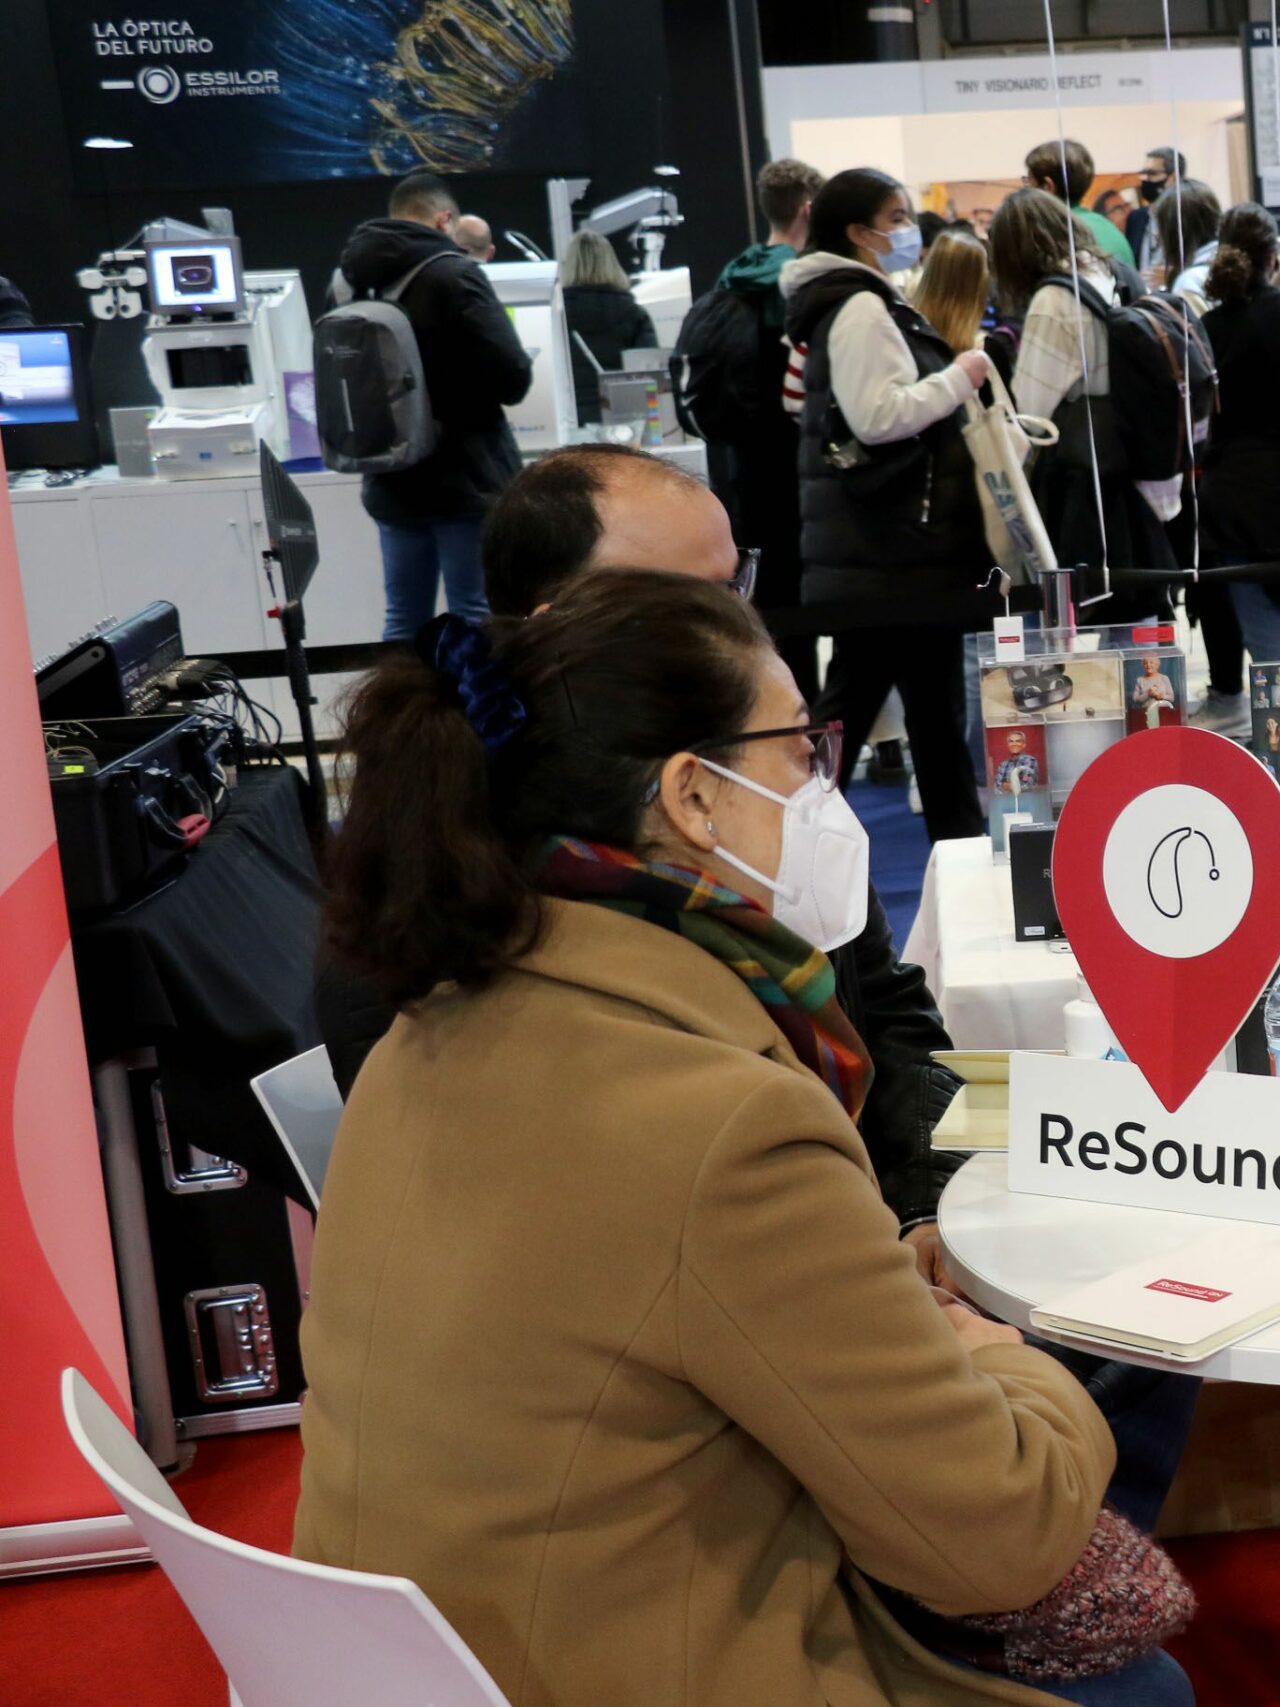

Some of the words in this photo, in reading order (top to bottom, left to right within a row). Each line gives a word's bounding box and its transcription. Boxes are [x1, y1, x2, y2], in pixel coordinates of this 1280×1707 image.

[93, 22, 119, 37] LA
[123, 19, 195, 37] ÓPTICA
[96, 40, 135, 56] DEL
[137, 38, 214, 55] FUTURO
[185, 69, 280, 86] ESSILOR
[955, 80, 980, 94] TINY
[985, 77, 1049, 93] VISIONARIO
[187, 85, 281, 97] INSTRUMENTS
[1157, 1281, 1208, 1295] ReSound
